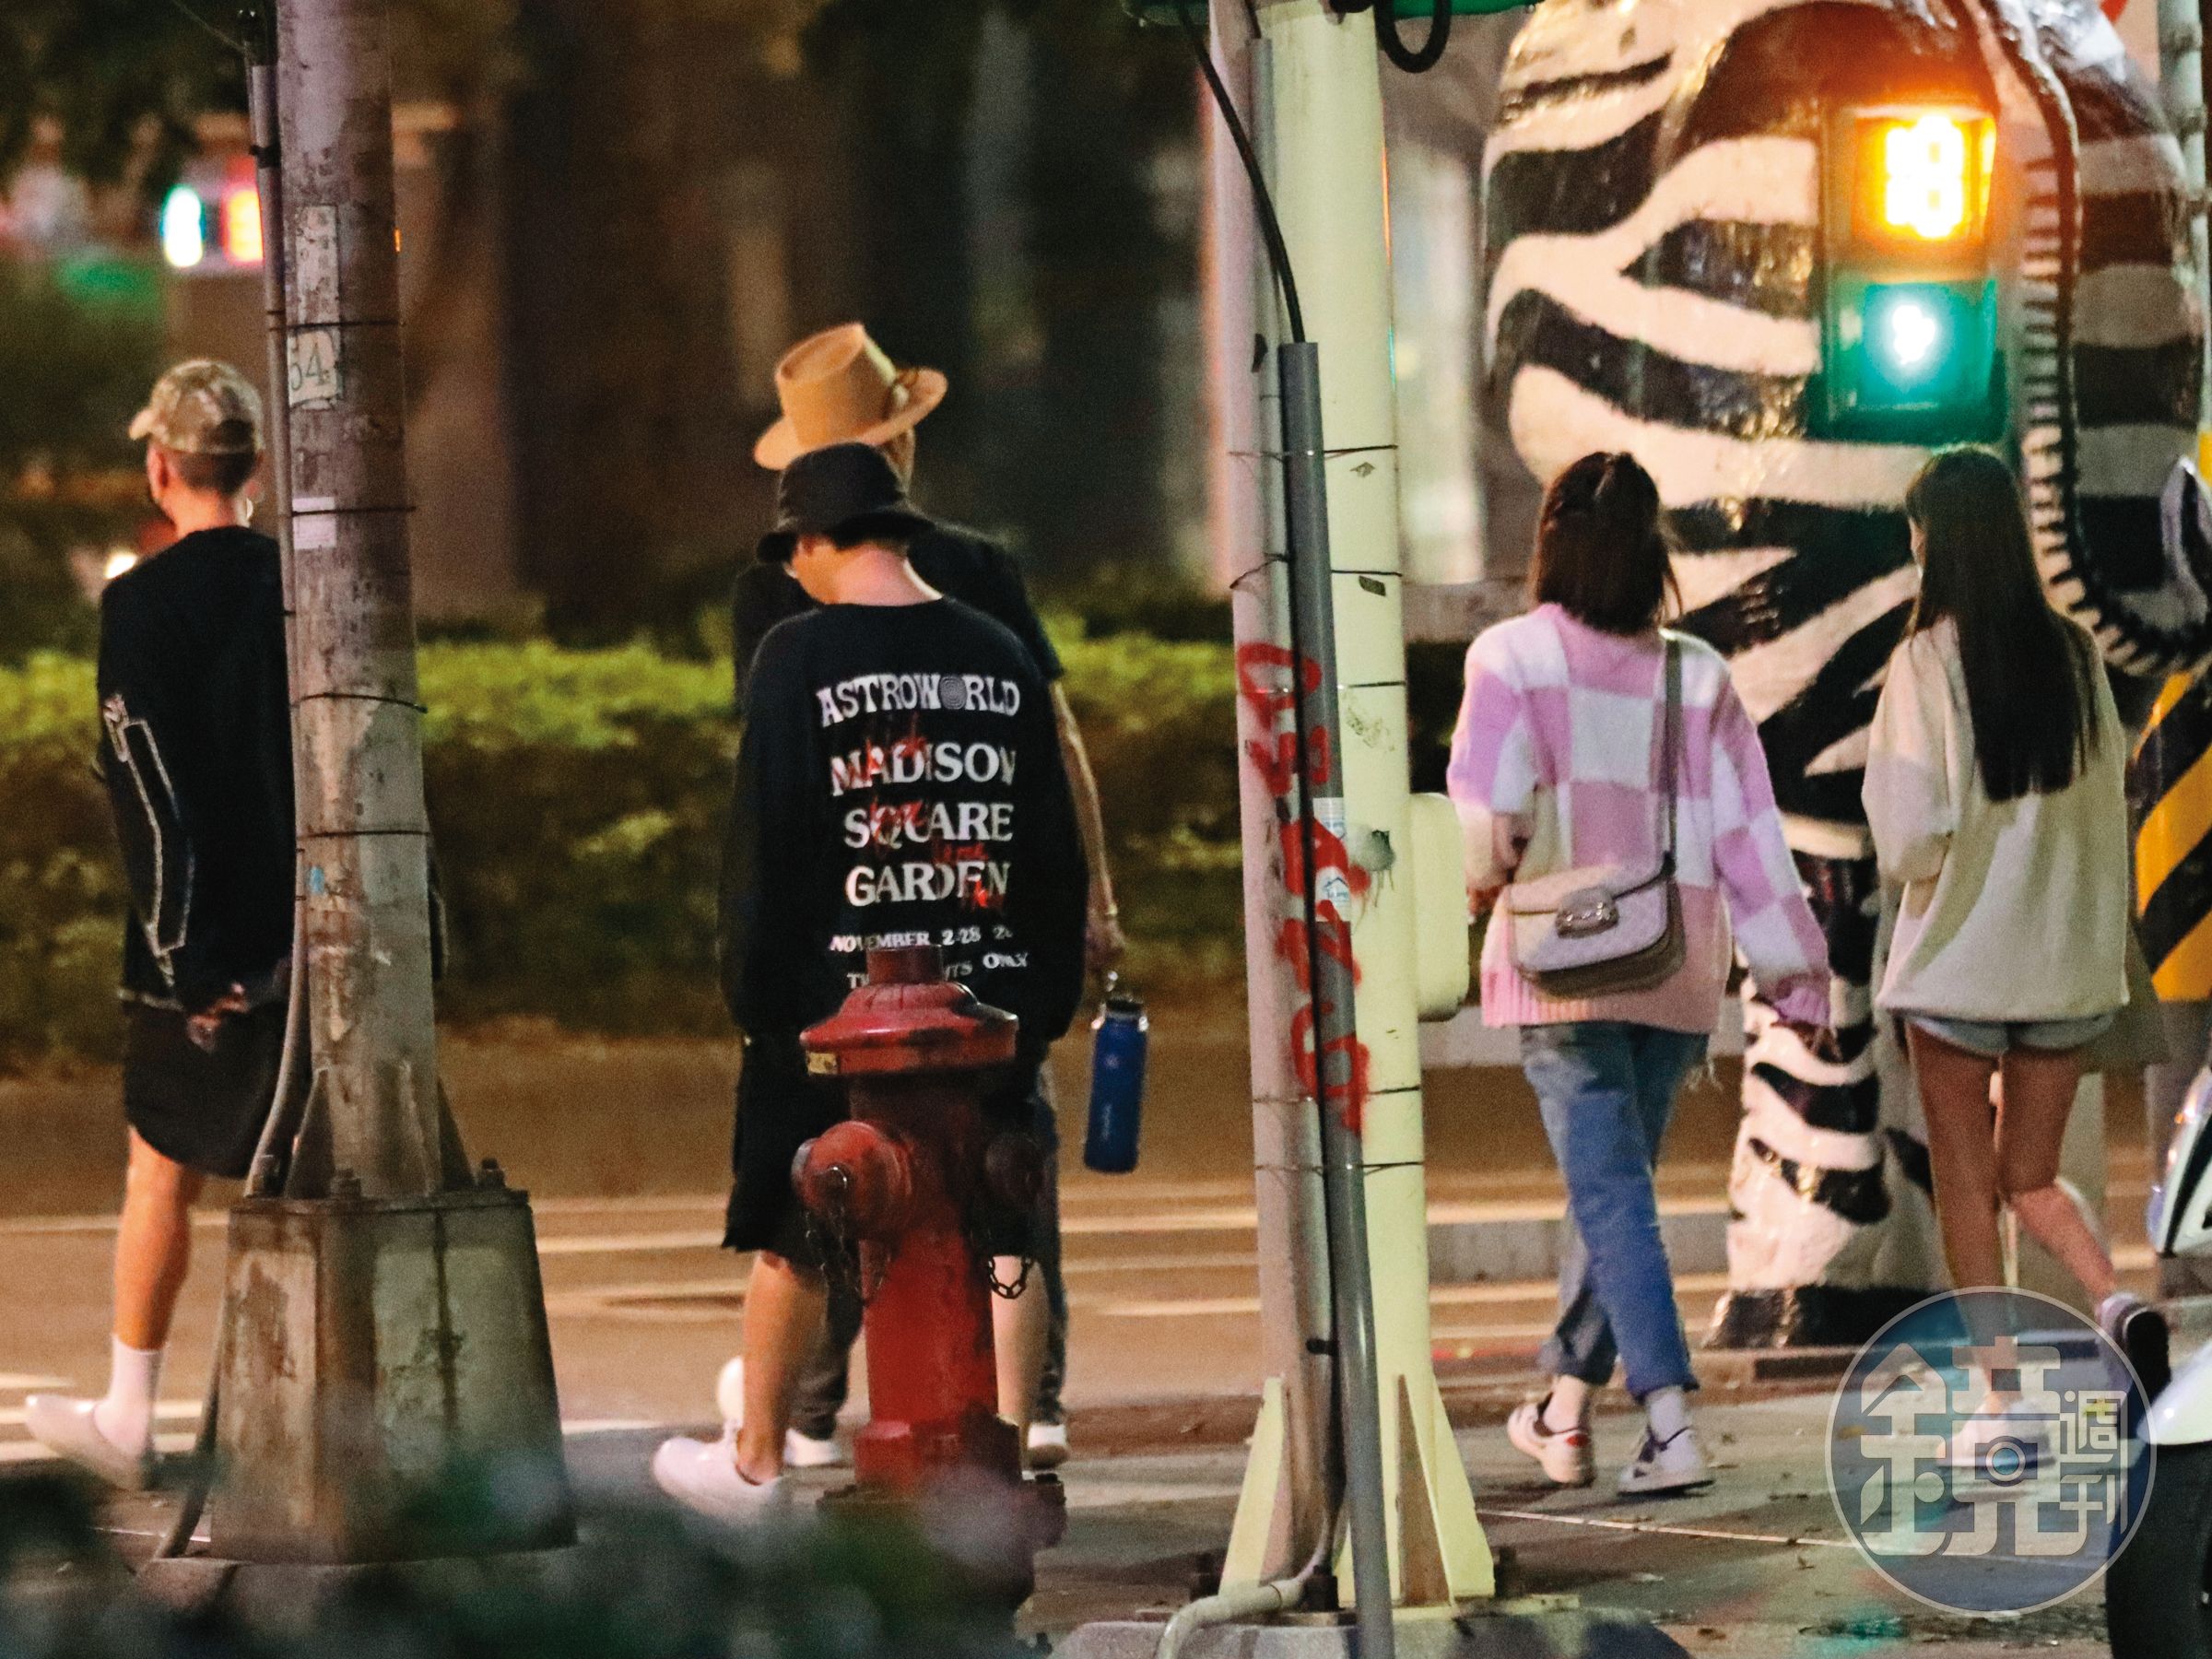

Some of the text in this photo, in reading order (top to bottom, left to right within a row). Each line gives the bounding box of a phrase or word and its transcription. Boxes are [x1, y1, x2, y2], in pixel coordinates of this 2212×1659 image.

[816, 673, 1021, 727] ASTROWORLD
[831, 741, 1017, 796] MADISON
[844, 802, 1014, 849] SQUARE
[845, 862, 1009, 907] GARDEN
[830, 931, 931, 952] NOVEMBER
